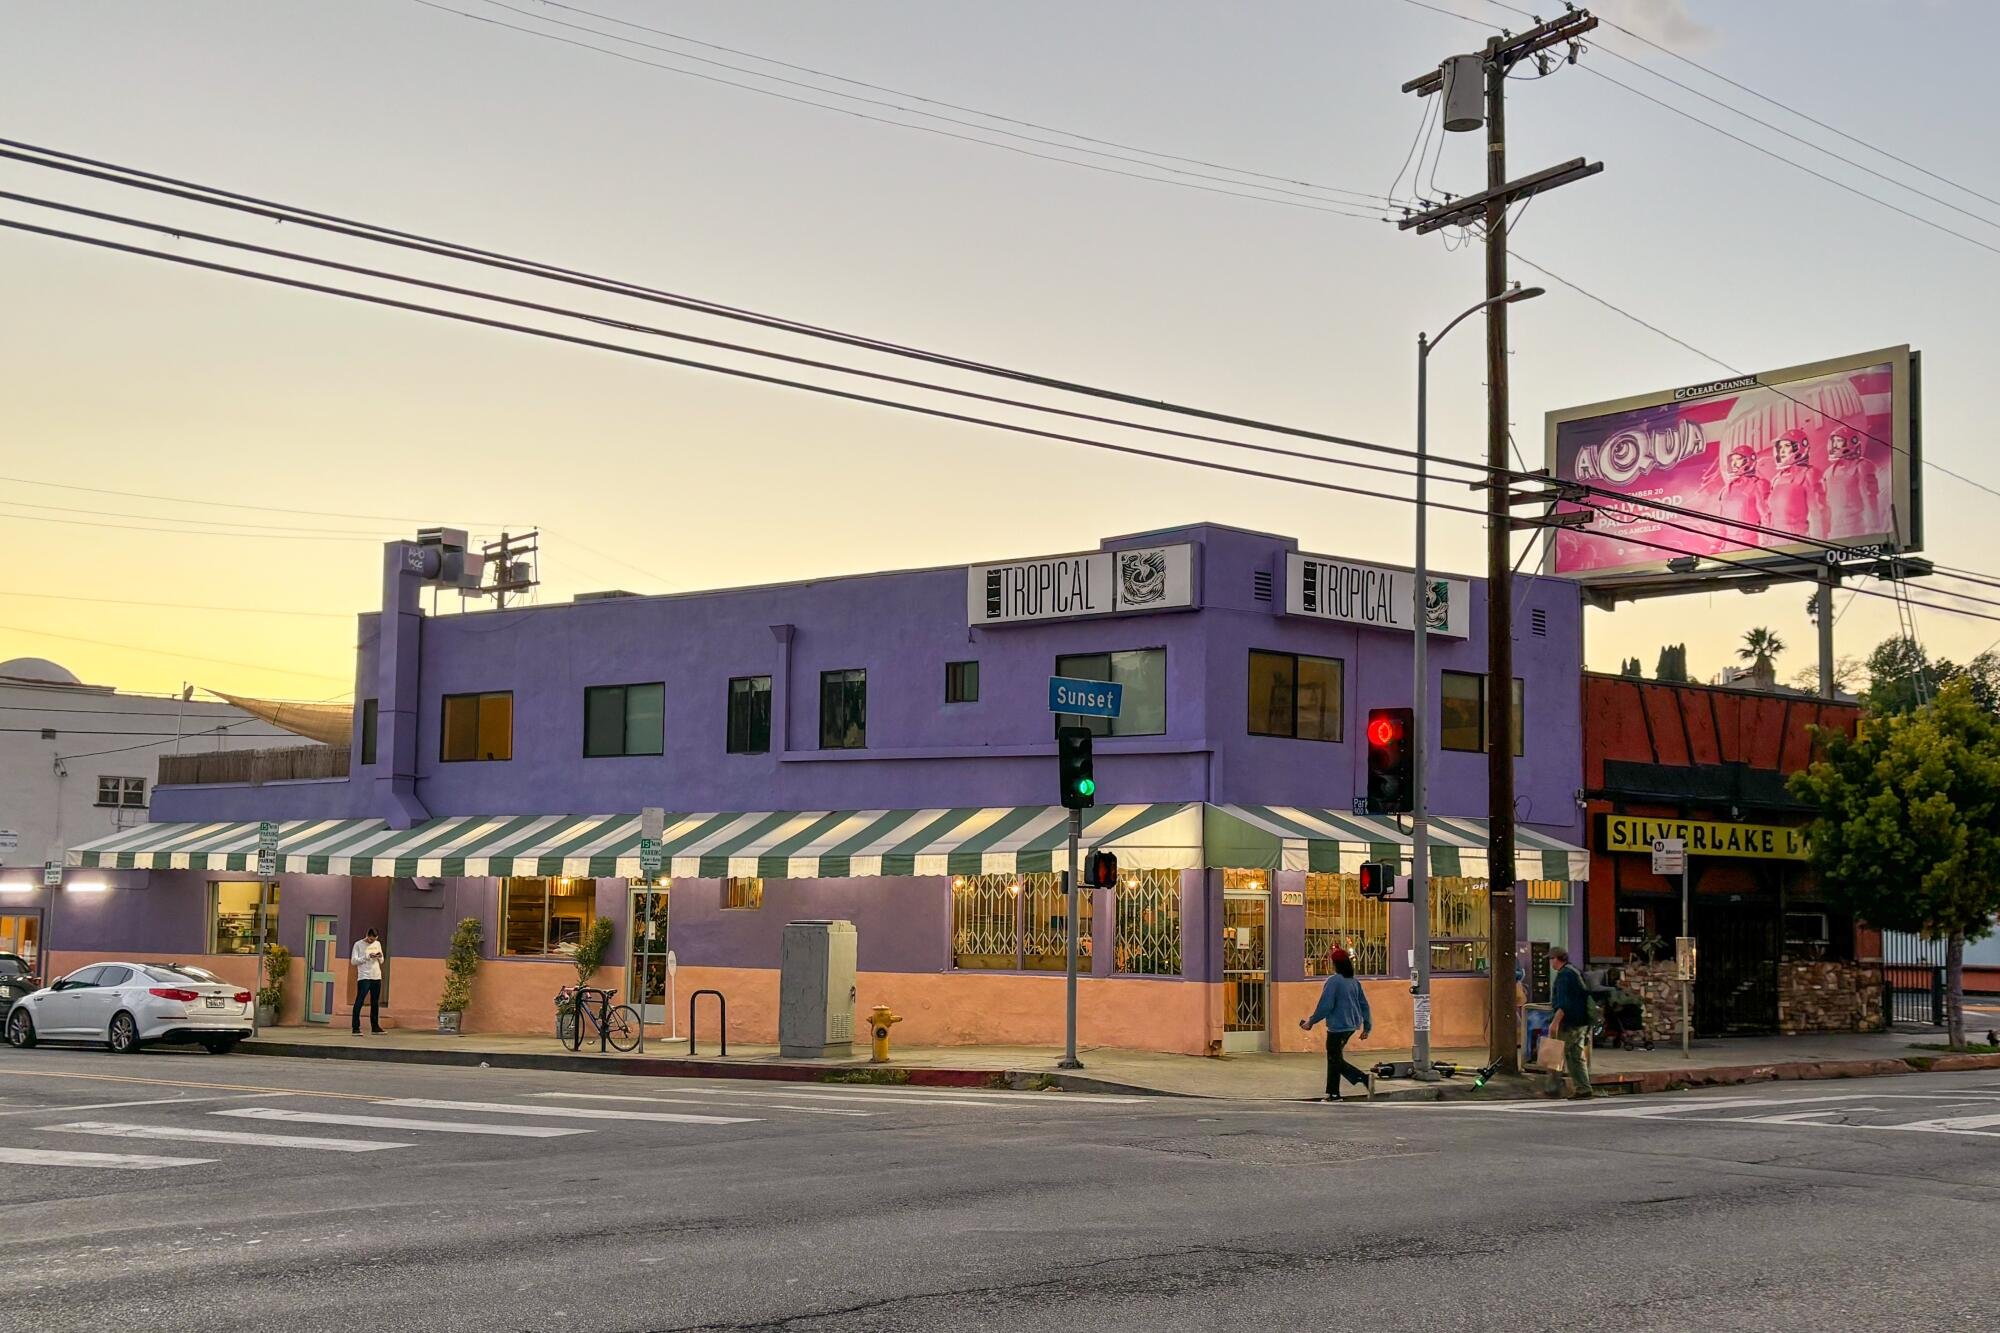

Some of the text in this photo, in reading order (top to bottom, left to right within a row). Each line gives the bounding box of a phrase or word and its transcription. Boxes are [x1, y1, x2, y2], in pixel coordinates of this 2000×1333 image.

[1575, 419, 1706, 486] AQUA
[1654, 487, 1664, 495] 20
[1629, 524, 1662, 534] ANGELES
[987, 569, 1001, 616] CAFE
[1002, 559, 1095, 617] TROPICAL
[1304, 562, 1316, 610] CAFE
[1318, 563, 1397, 624] TROPICAL
[1057, 686, 1113, 709] Sunset
[642, 840, 650, 848] 15
[1613, 820, 1774, 853] SILVERLAKE
